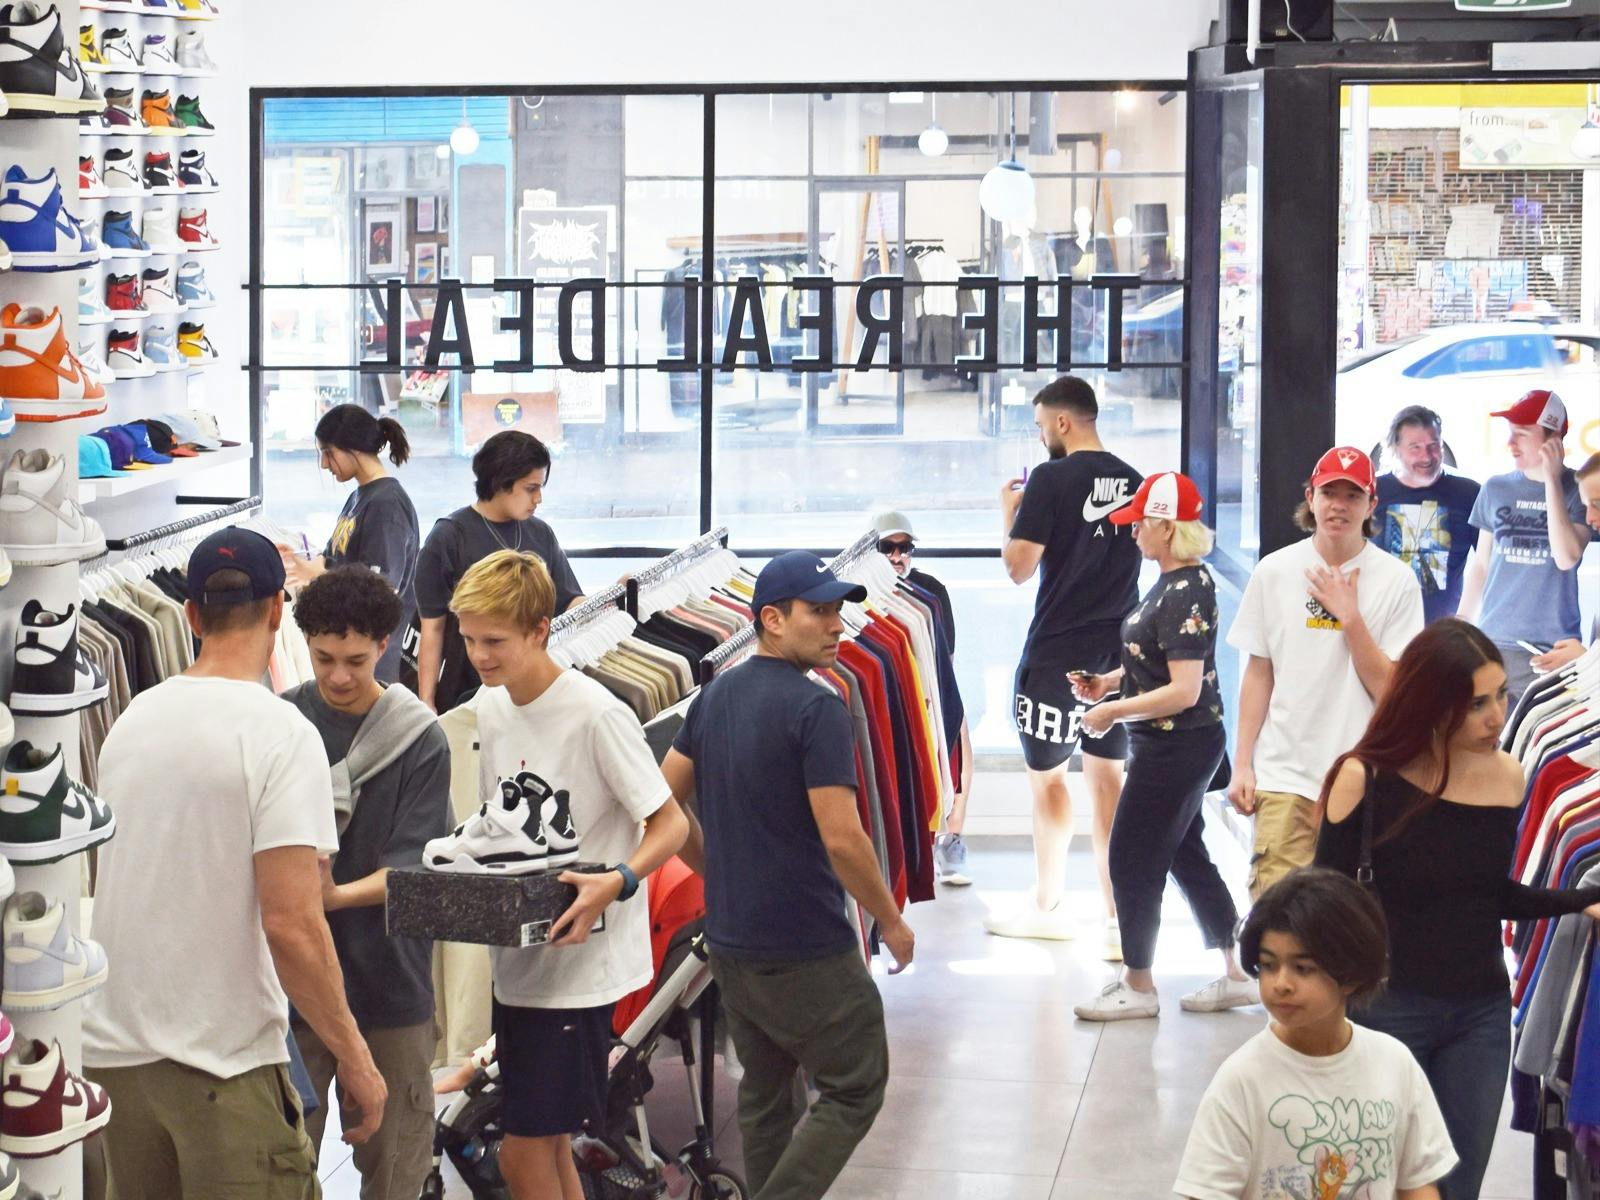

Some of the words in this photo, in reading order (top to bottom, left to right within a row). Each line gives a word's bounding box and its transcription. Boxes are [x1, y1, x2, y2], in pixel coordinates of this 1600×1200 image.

[1092, 477, 1130, 503] NIKE
[1153, 502, 1169, 512] 22
[1268, 1094, 1361, 1149] TOM
